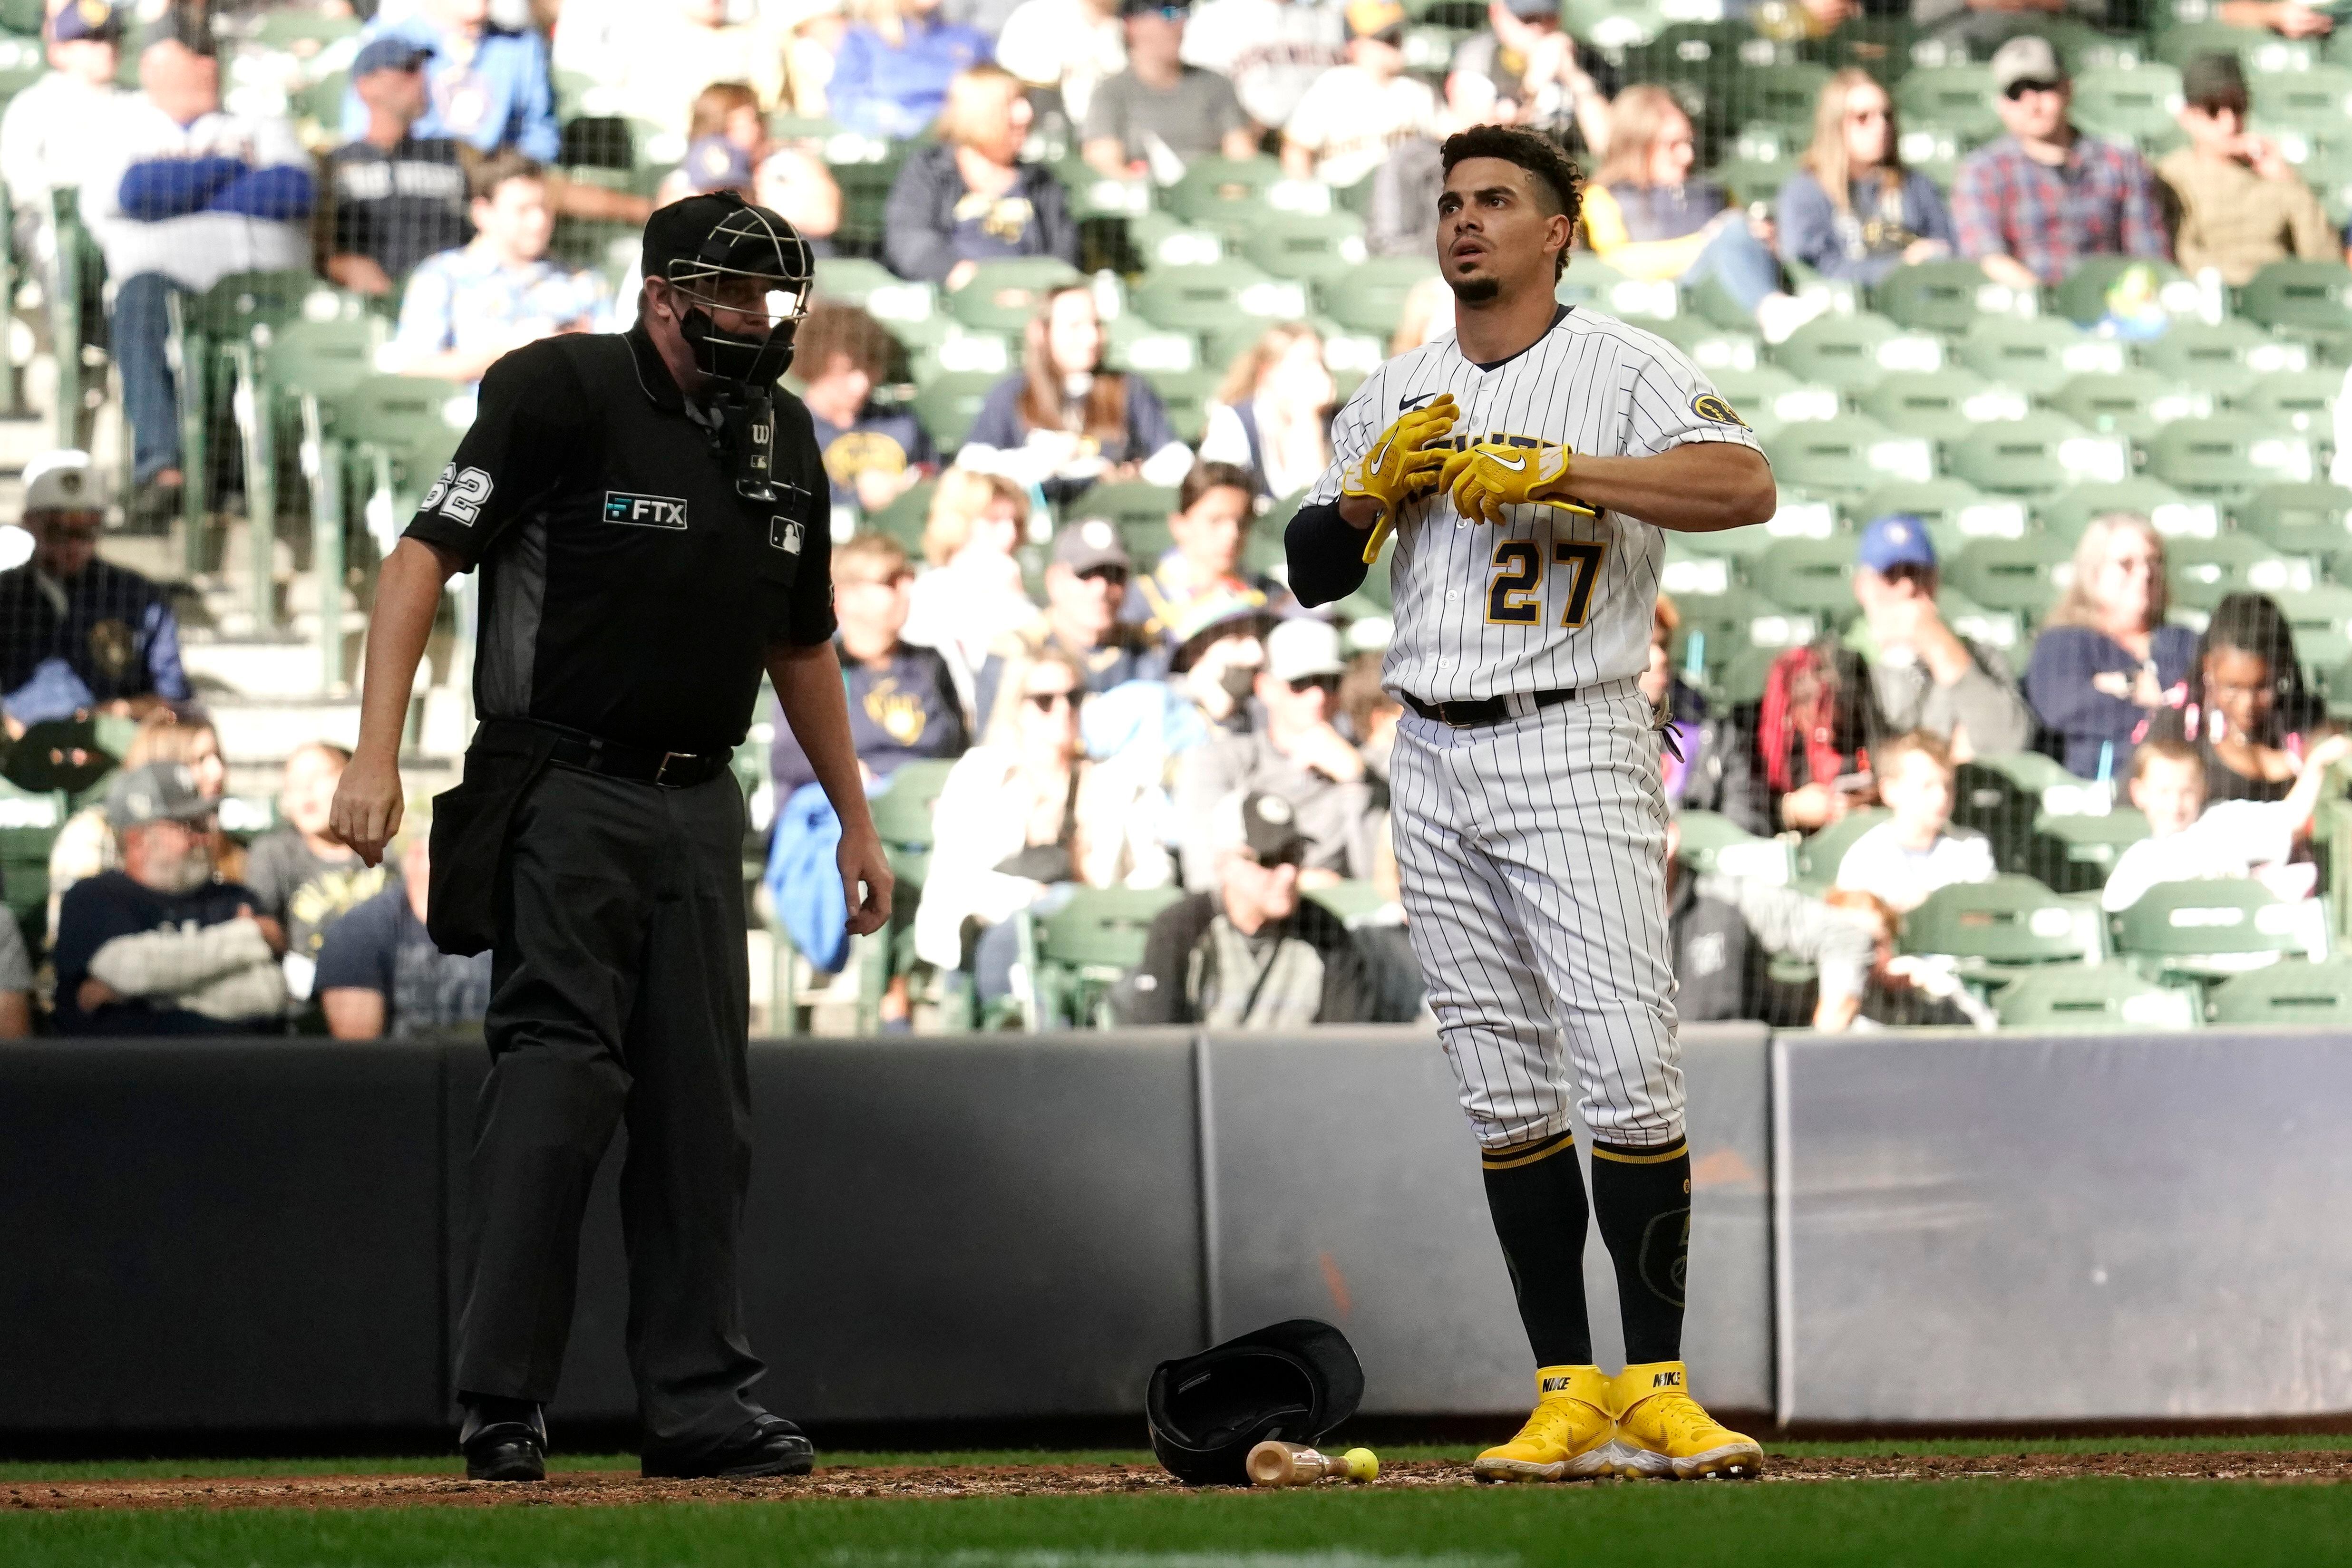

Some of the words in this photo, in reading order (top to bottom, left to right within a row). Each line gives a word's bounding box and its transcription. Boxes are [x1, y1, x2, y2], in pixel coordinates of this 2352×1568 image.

[632, 499, 684, 526] FTX
[1486, 540, 1608, 629] 27
[1542, 1377, 1571, 1393] NIKE
[1652, 1372, 1681, 1388] NIKE
